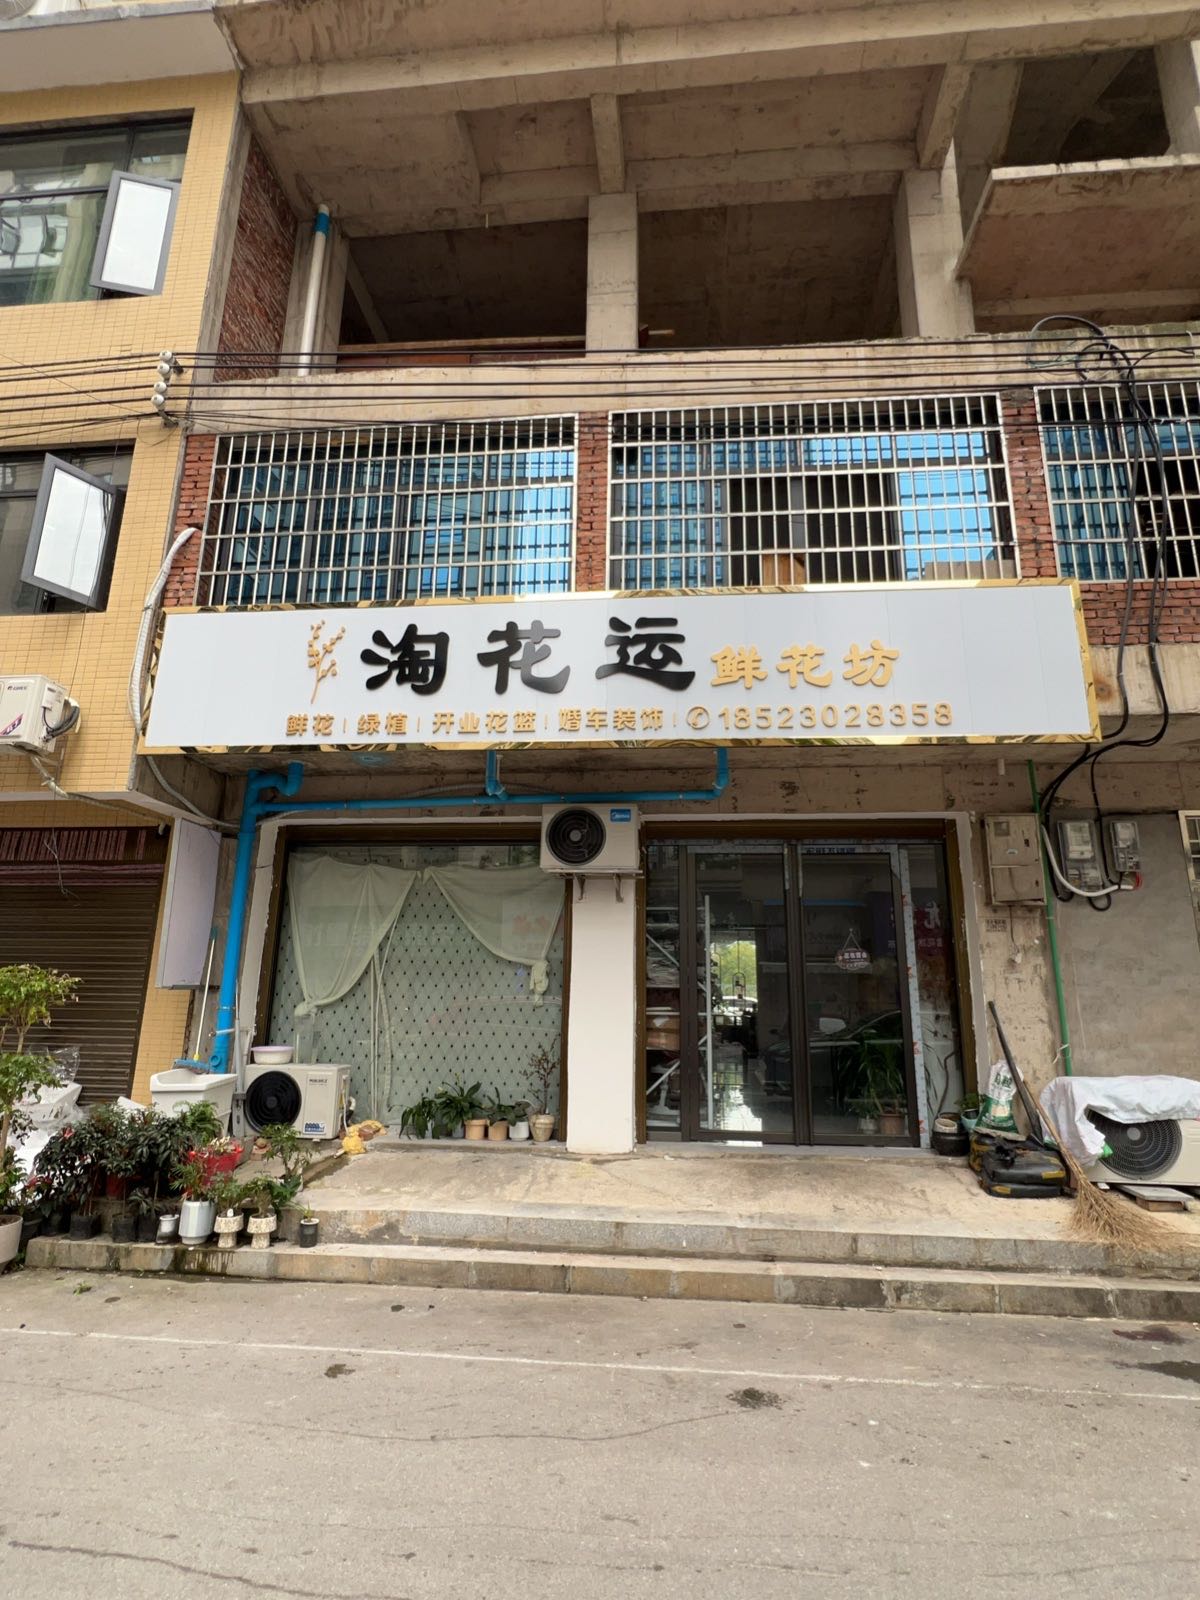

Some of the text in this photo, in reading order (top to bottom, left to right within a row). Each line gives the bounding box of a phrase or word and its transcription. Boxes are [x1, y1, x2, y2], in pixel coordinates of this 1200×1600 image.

[361, 616, 899, 695] 淘花运 鲜花坊
[286, 703, 953, 737] 鲜花 绿植 开业花篮 婚车装饰 18523028358
